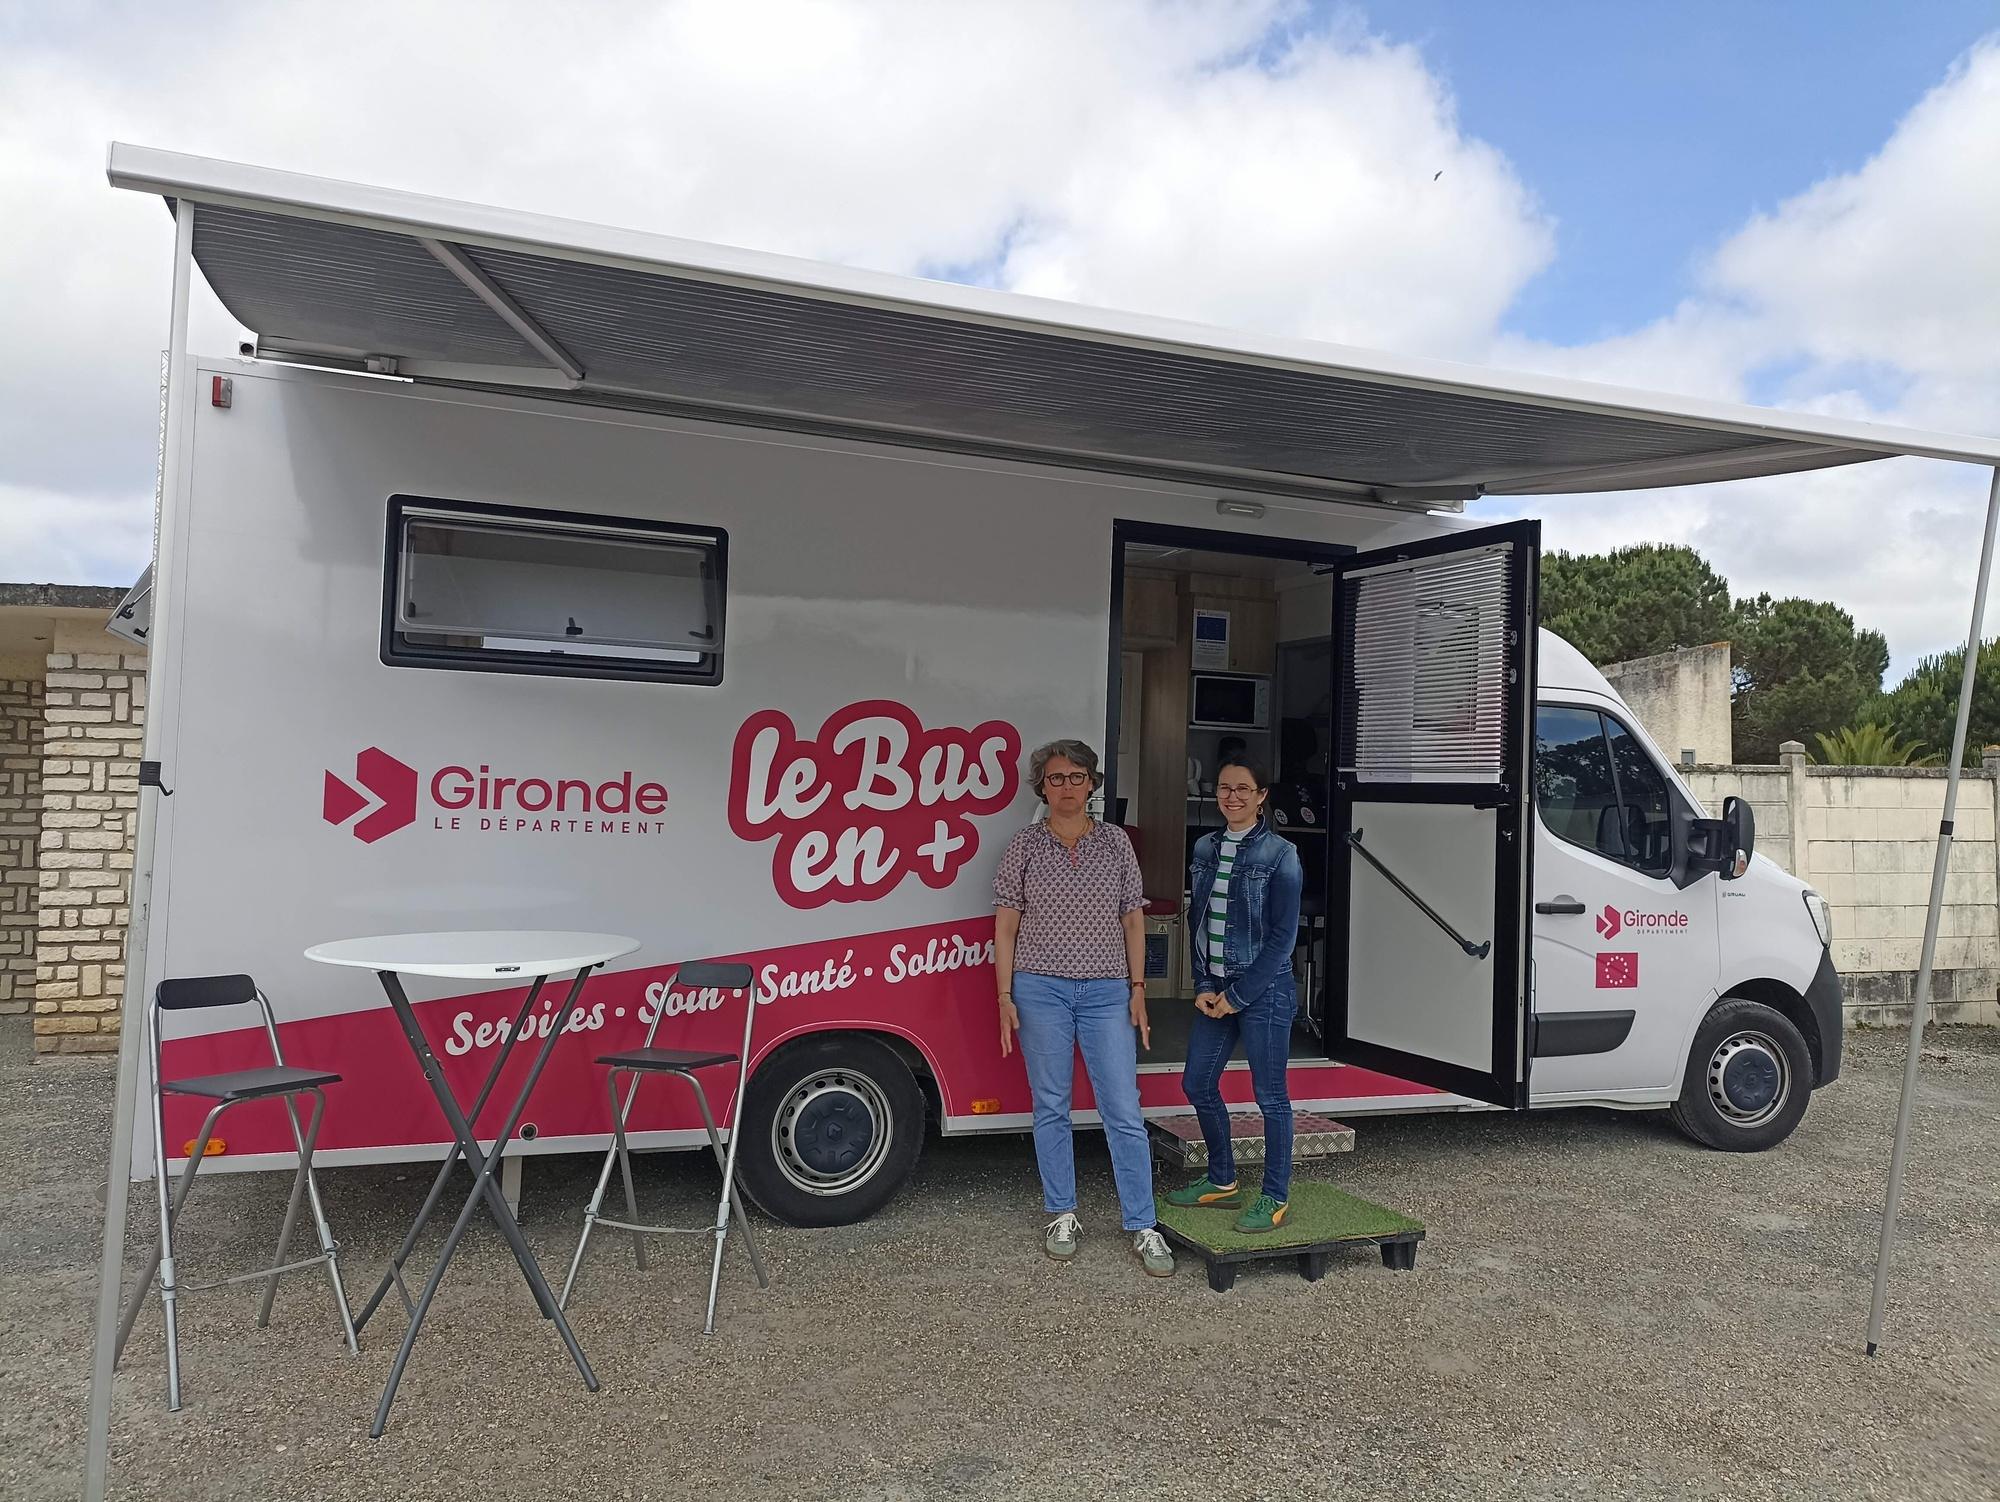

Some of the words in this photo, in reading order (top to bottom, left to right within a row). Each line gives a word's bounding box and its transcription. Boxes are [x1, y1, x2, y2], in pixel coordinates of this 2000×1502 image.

[430, 764, 669, 815] Gironde
[745, 726, 832, 825] le
[833, 715, 1007, 811] Bus
[434, 816, 461, 830] LE
[480, 815, 665, 834] DÉPARTEMENT
[789, 826, 900, 893] en
[916, 819, 965, 873] +
[1623, 909, 1689, 927] Gironde
[444, 1000, 606, 1056] Servies
[756, 949, 857, 1005] Santé
